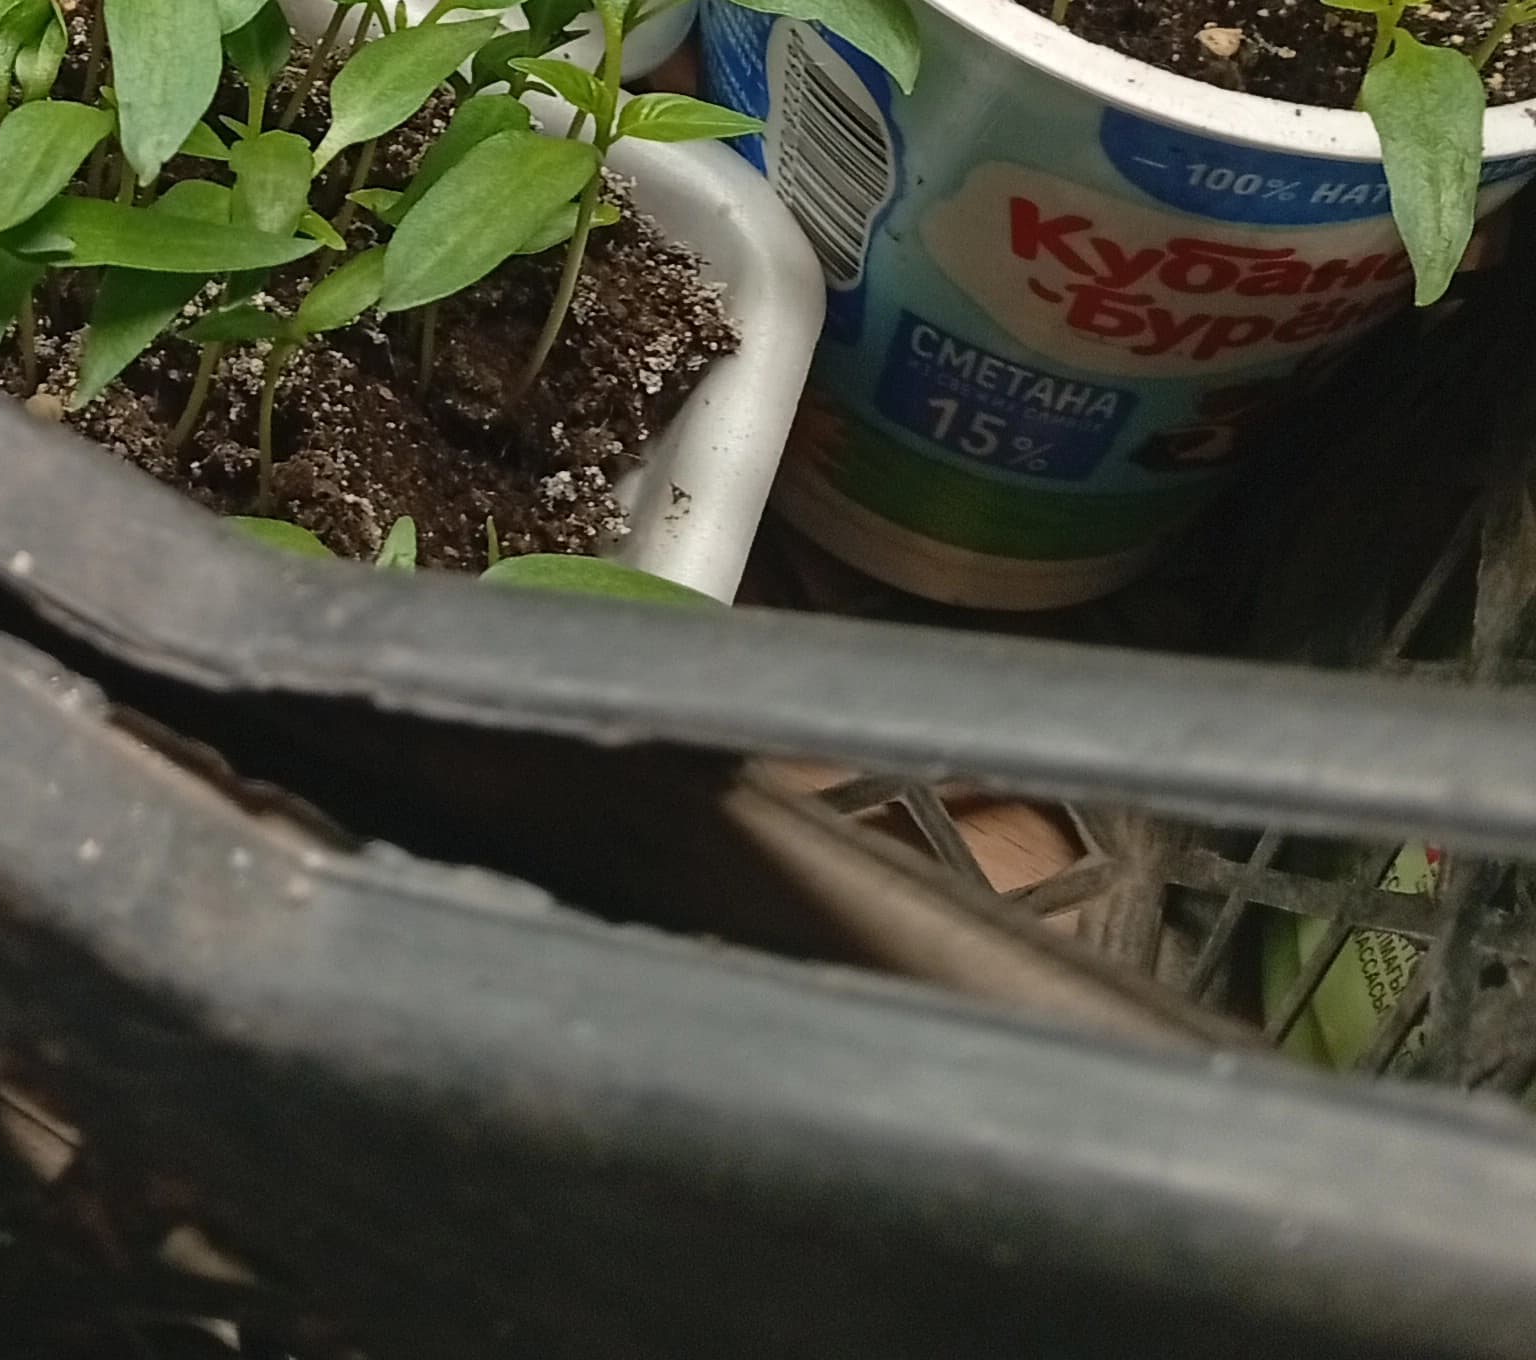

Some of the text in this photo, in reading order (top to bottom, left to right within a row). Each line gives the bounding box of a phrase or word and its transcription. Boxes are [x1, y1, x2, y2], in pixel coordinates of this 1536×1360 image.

[1187, 163, 1388, 206] 100% НАТ
[1009, 197, 1414, 297] Кубанс
[911, 325, 1120, 419] СМЕТАНА
[1353, 932, 1391, 1015] АССАСЫ
